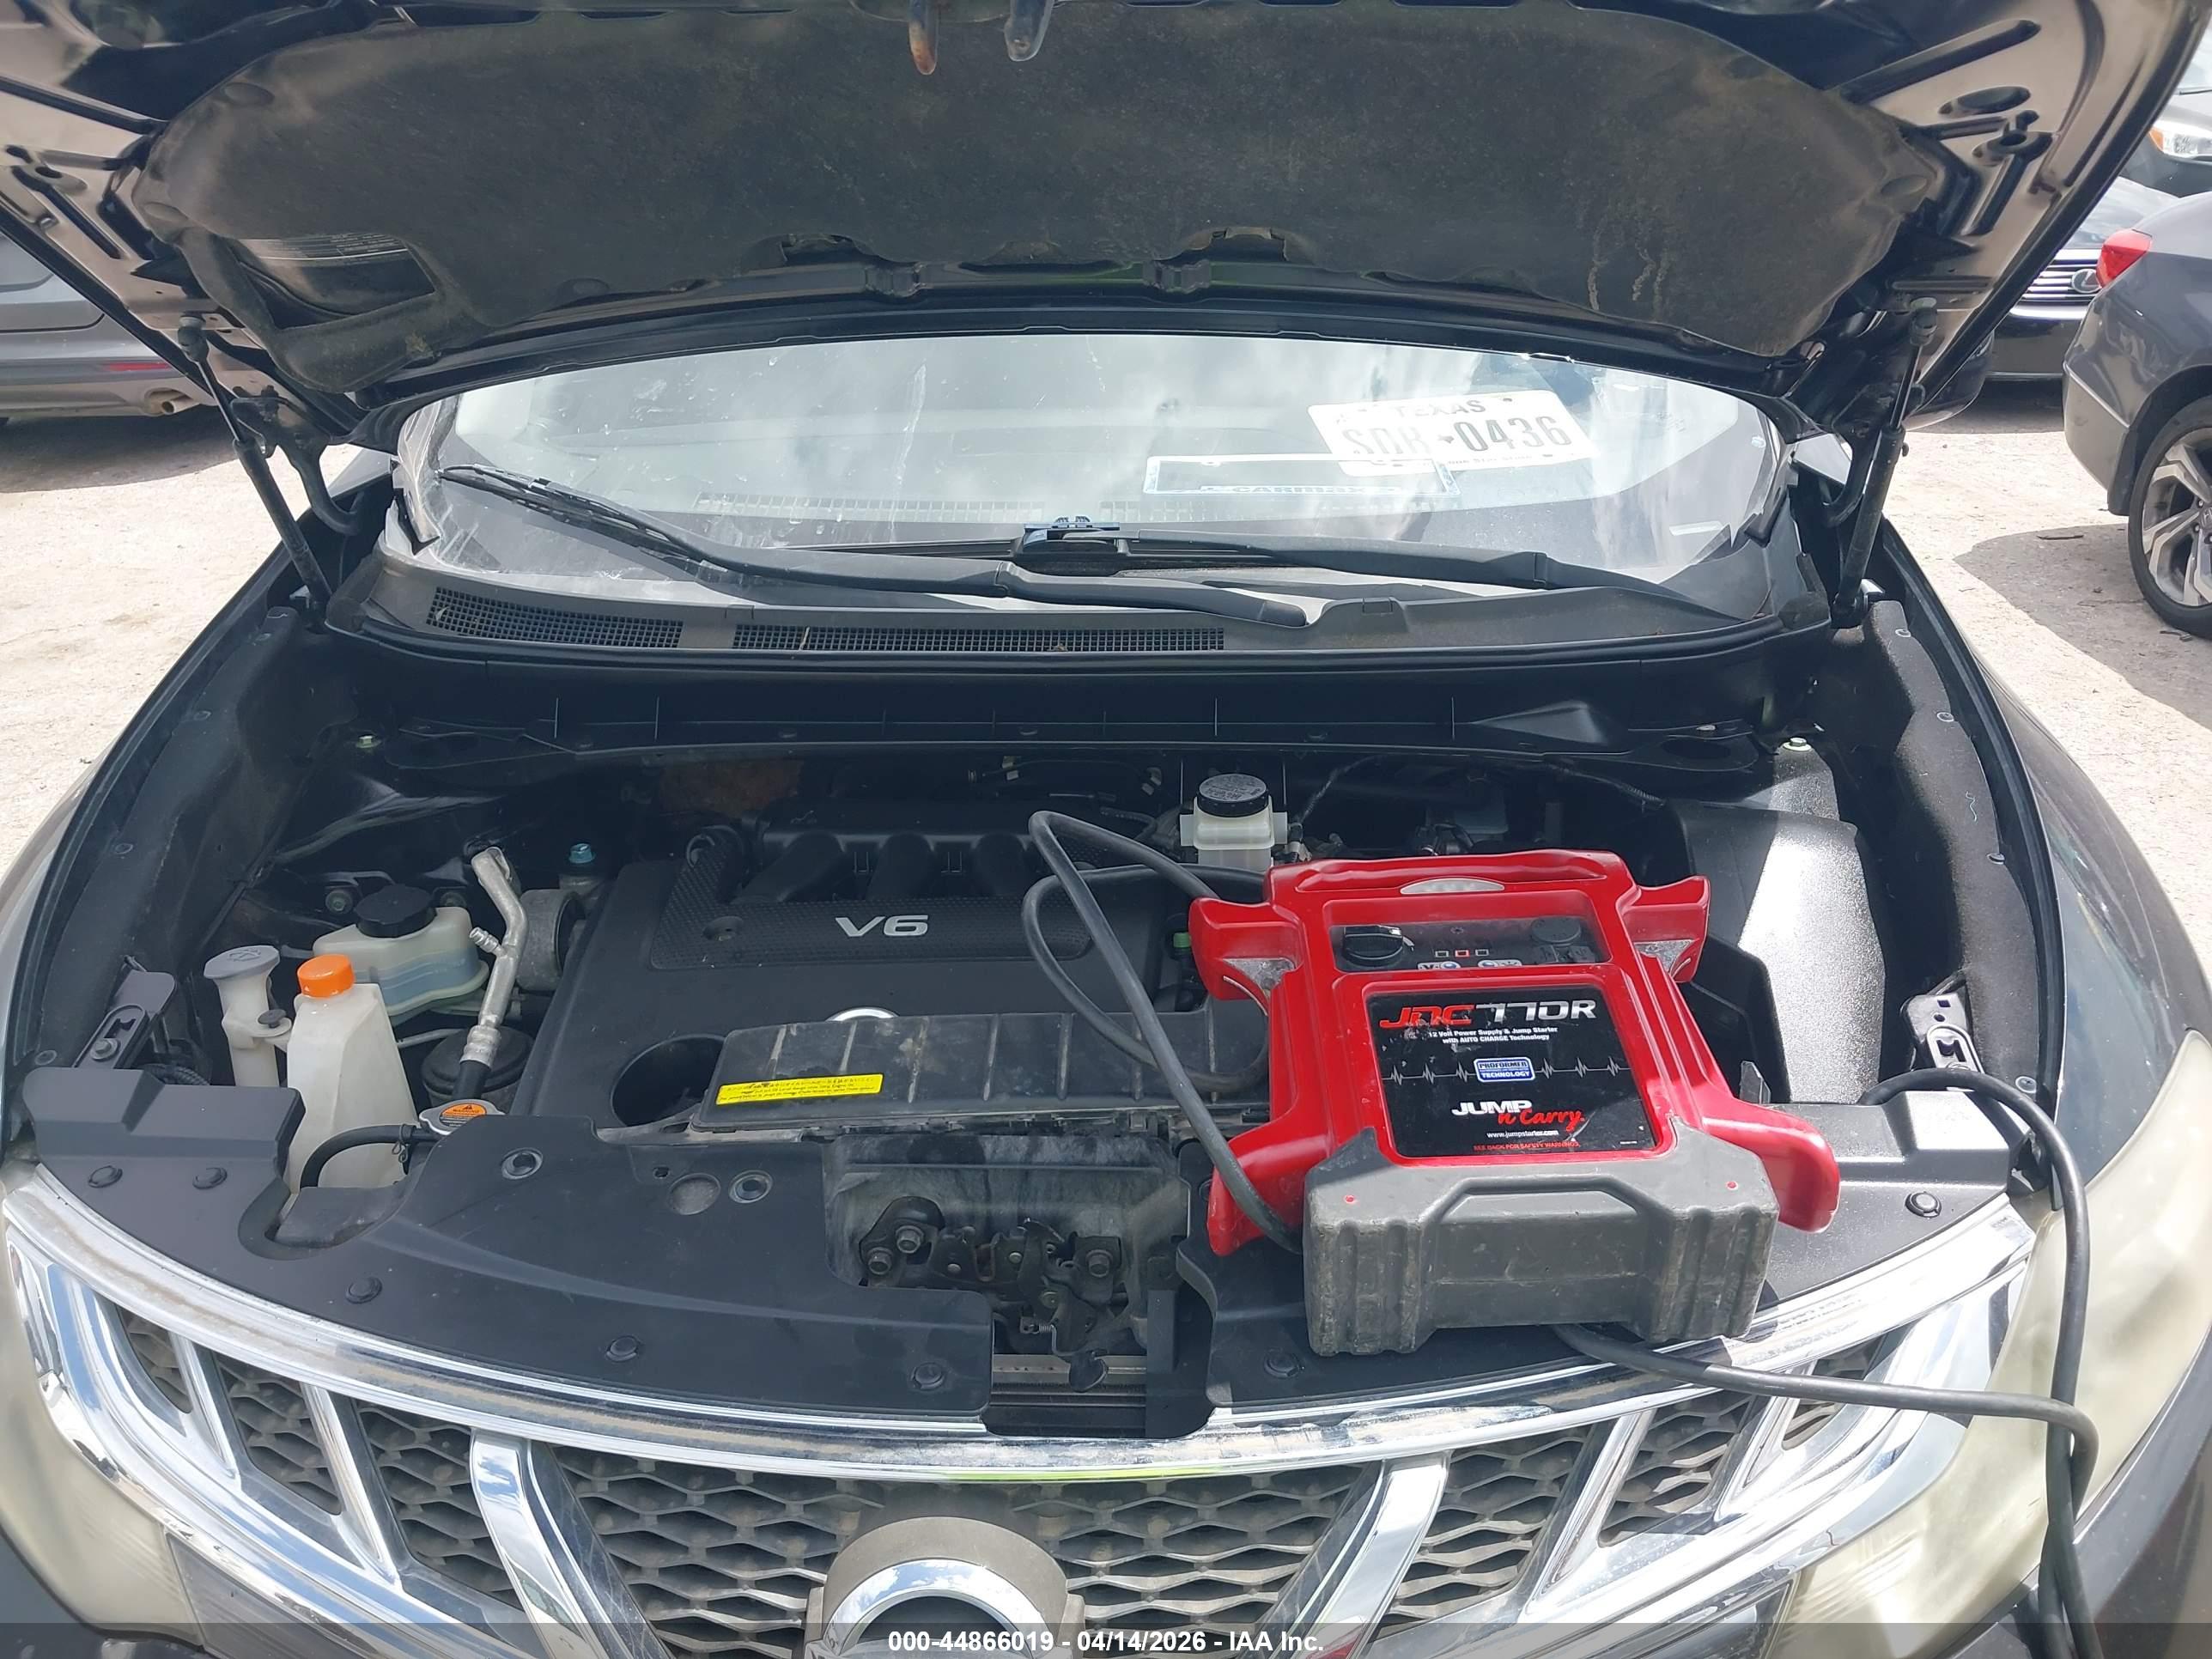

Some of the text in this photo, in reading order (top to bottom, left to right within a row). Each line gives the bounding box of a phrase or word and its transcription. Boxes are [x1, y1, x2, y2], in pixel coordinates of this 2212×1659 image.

[1453, 416, 1572, 452] 0436
[836, 915, 928, 937] V6
[1451, 1100, 1532, 1115] JUMP
